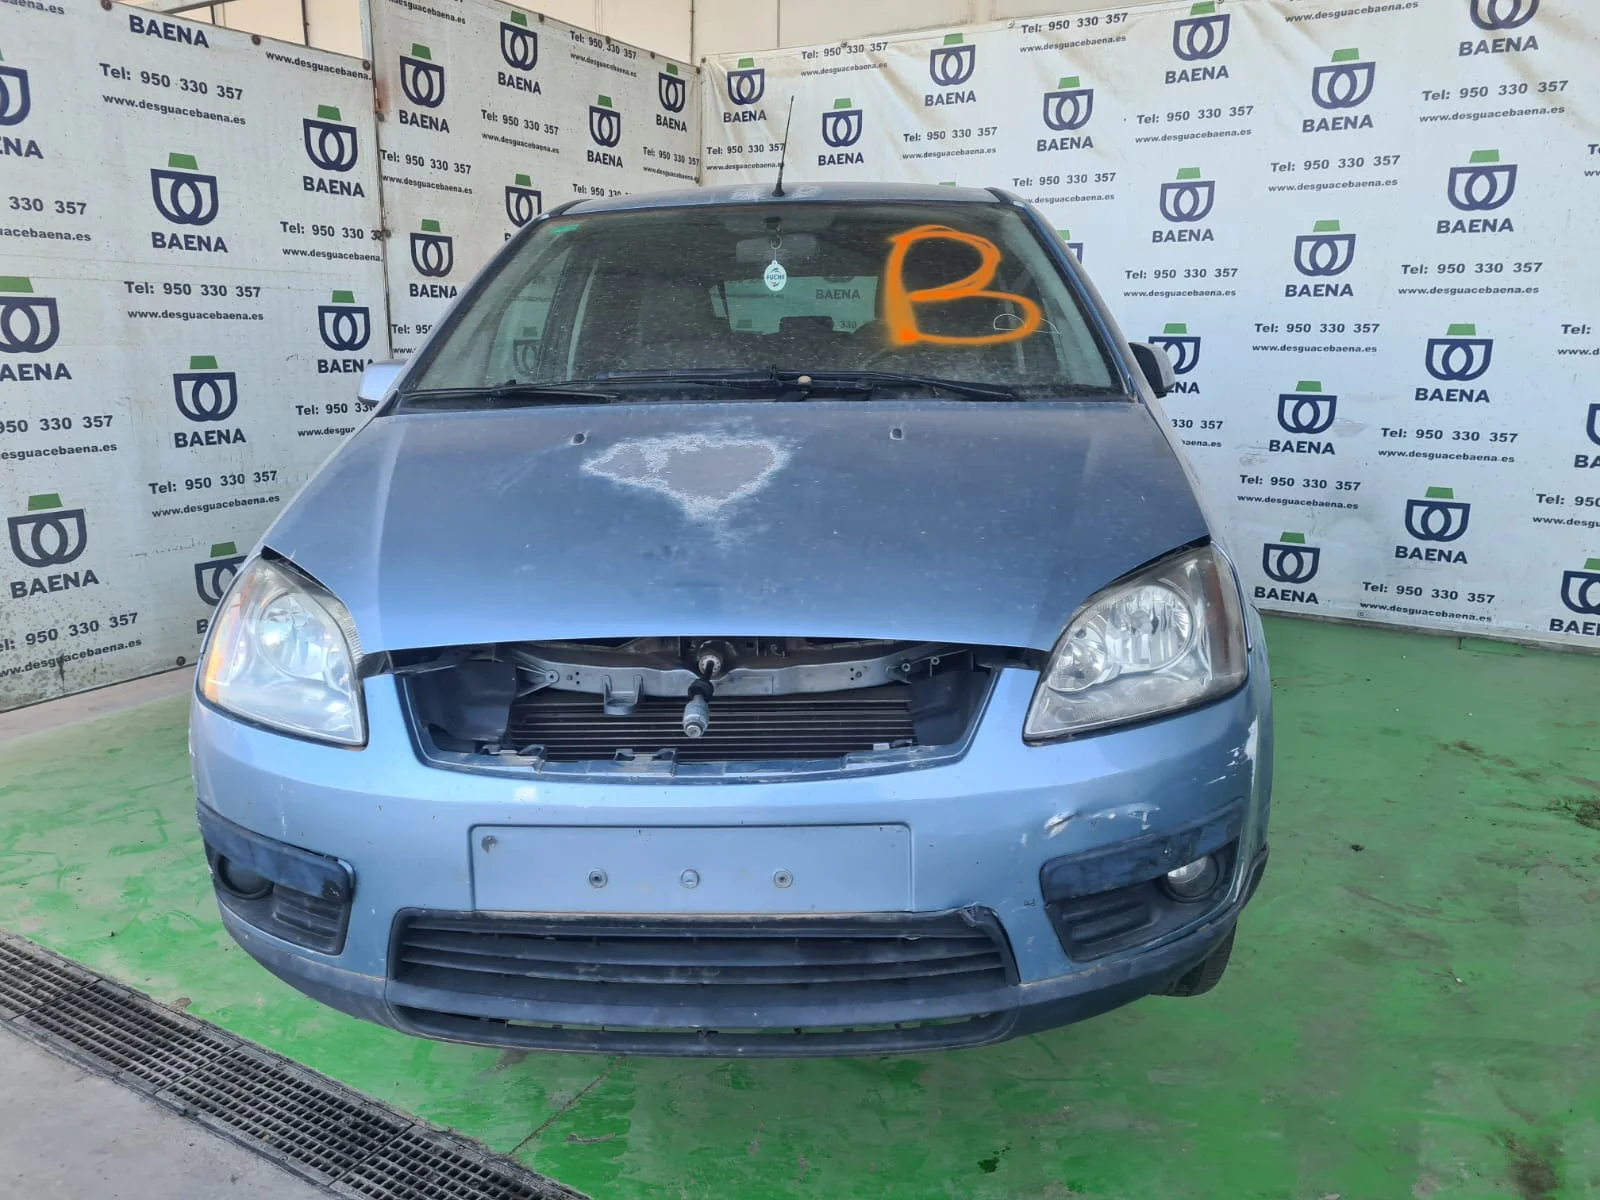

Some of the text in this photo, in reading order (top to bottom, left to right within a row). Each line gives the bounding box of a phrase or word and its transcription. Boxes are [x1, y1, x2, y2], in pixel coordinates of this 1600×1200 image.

[1285, 1, 1418, 23] www.desguacebaena.es
[129, 14, 209, 48] BAENA
[1021, 13, 1128, 33] Tel: 950 330 357
[570, 30, 636, 59] Tel: 950 330 357
[802, 42, 888, 59] Tel: 950 330 357
[1020, 36, 1126, 52] www.desguacebaena.es
[1459, 36, 1538, 56] BAENA
[99, 63, 242, 100] Tel: 950 330 357
[1165, 66, 1229, 84] BAENA
[498, 72, 541, 95] BAENA
[1422, 80, 1568, 101] Tel: 950 330 357
[925, 90, 976, 106] BAENA
[102, 94, 246, 125] www.desguacebaena.es
[724, 110, 767, 122] BAENA
[1137, 106, 1253, 124] Tel: 950 330 357
[1420, 107, 1565, 122] www.desguacebaena.es
[399, 109, 449, 133] BAENA
[481, 109, 558, 135] Tel: 950 330 357
[656, 114, 687, 132] BAENA
[1303, 115, 1373, 133] BAENA
[904, 127, 997, 142] Tel: 950 330 357
[1136, 130, 1251, 143] www.desguacebaena.es
[727, 146, 743, 154] 950
[748, 145, 764, 153] 330
[1037, 136, 1093, 152] BAENA
[587, 150, 623, 168] BAENA
[643, 146, 700, 166] Tel: 950 330 357
[818, 152, 864, 166] BAENA
[903, 148, 996, 159] www.desguacebaena.es
[381, 150, 471, 174] Tel: 950 330 357
[1271, 155, 1400, 172] Tel: 950 330 357
[303, 176, 365, 197] BAENA
[382, 174, 473, 195] www.desguacebaena.es
[1013, 173, 1116, 187] Tel: 950 330 357
[1269, 180, 1397, 192] www.desguacebaena.es
[573, 184, 604, 196] Tel: 950
[9, 196, 86, 215] 330 357
[280, 221, 363, 239] Tel: 950 330
[1437, 218, 1513, 233] BAENA
[152, 232, 228, 253] BAENA
[1152, 229, 1214, 243] BAENA
[1125, 268, 1238, 279] Tel: 950 330 357
[1402, 262, 1543, 274] Tel: 950 330 357
[124, 281, 260, 297] Tel: 950 330 357
[409, 284, 457, 298] BAENA
[884, 223, 1042, 346] B
[1285, 284, 1353, 297] BAENA
[1398, 286, 1539, 295] www.desguacebaena.es
[816, 289, 861, 299] BAENA
[1124, 289, 1236, 298] www.desguacebaena.es
[128, 310, 263, 321] www.desguacebaena.es
[392, 324, 410, 335] Tel:
[1255, 324, 1380, 333] Tel: 950 330 357
[1561, 324, 1590, 334] Tel:
[1252, 344, 1376, 353] www.desguacebaena.es
[1415, 388, 1489, 403] BAENA
[296, 403, 348, 415] Tel: 950
[40, 415, 113, 431] 330 357
[1201, 420, 1223, 429] 357
[174, 428, 246, 448] BAENA
[1381, 428, 1518, 443] Tel: 950 330 357
[1269, 440, 1335, 455] BAENA
[148, 470, 277, 494] Tel: 950 330 357
[1240, 475, 1360, 491] Tel: 950 330 357
[152, 496, 280, 517] www.desguacebaena.es
[1237, 496, 1358, 509] www.desguacebaena.es
[1536, 494, 1564, 504] Tel:
[1395, 546, 1467, 564] BAENA
[10, 570, 99, 599] BAENA
[1363, 582, 1495, 603] Tel: 950 330 357
[1255, 586, 1319, 604] BAENA
[1359, 601, 1492, 622] www.desguacebaena.es
[26, 612, 138, 645] 950 330 357
